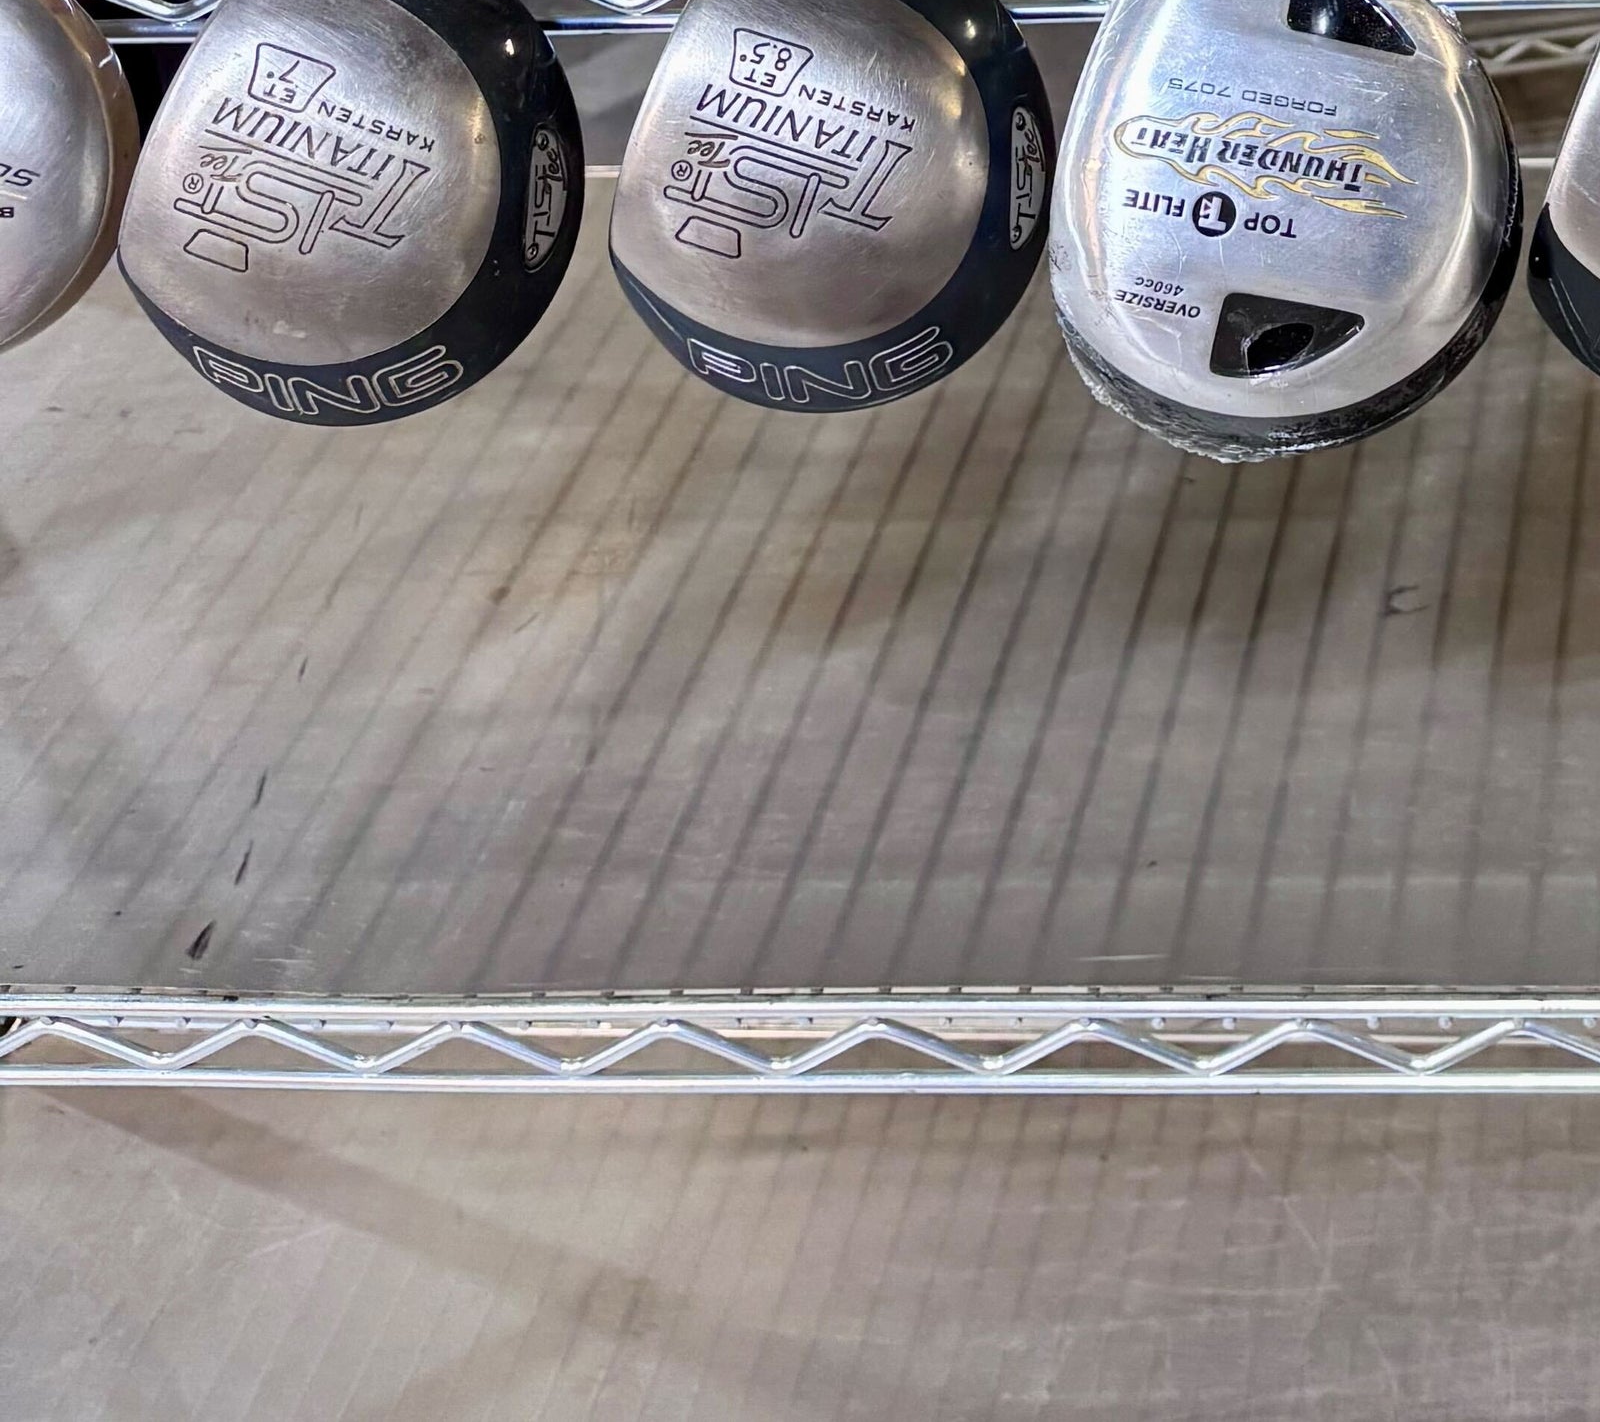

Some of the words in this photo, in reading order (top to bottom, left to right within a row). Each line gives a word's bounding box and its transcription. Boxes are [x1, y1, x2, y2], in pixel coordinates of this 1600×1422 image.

[1167, 75, 1232, 100] 7075
[1240, 89, 1338, 117] FORGED
[318, 101, 436, 154] KARSTEN
[798, 84, 917, 133] KARSTEN
[1130, 126, 1214, 166] HEAT
[1218, 137, 1368, 194] THUNDER
[1122, 187, 1187, 219] FLITE
[1243, 212, 1298, 239] TOP
[1114, 287, 1201, 320] OVERSIZE
[193, 345, 464, 415] PING
[687, 326, 954, 403] PING
